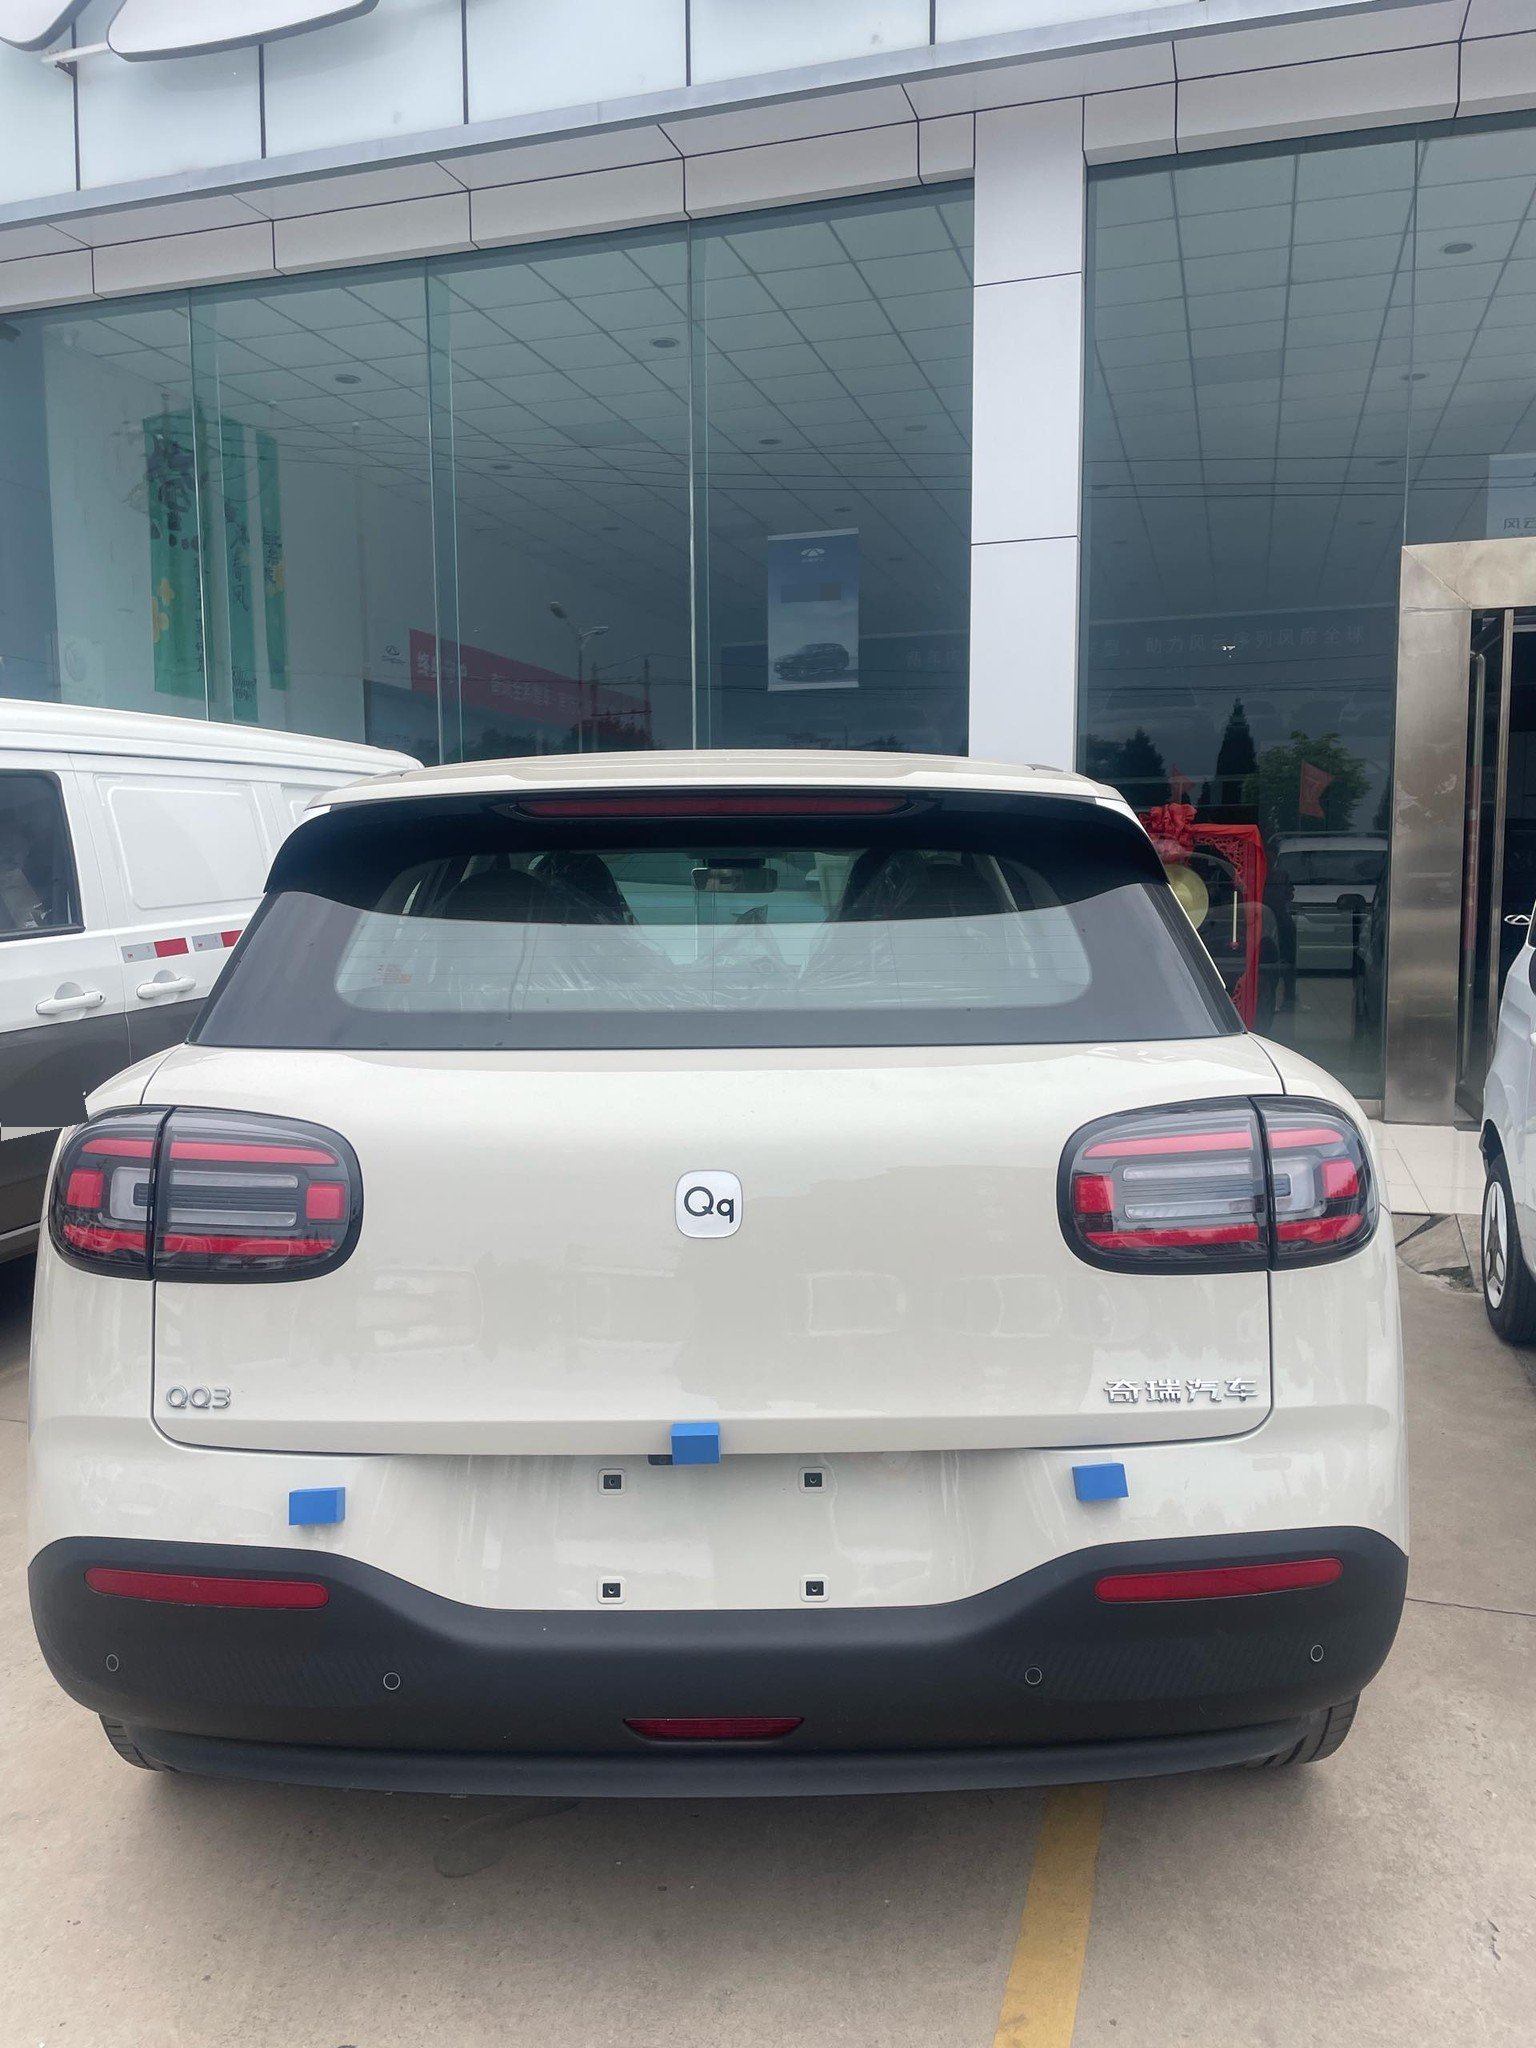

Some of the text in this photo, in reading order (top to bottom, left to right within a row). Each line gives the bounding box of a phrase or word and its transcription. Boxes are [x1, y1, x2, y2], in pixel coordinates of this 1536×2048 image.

[683, 1186, 734, 1224] Qq
[166, 1384, 231, 1409] QQ3
[1103, 1377, 1259, 1404] 奇瑞汽车
